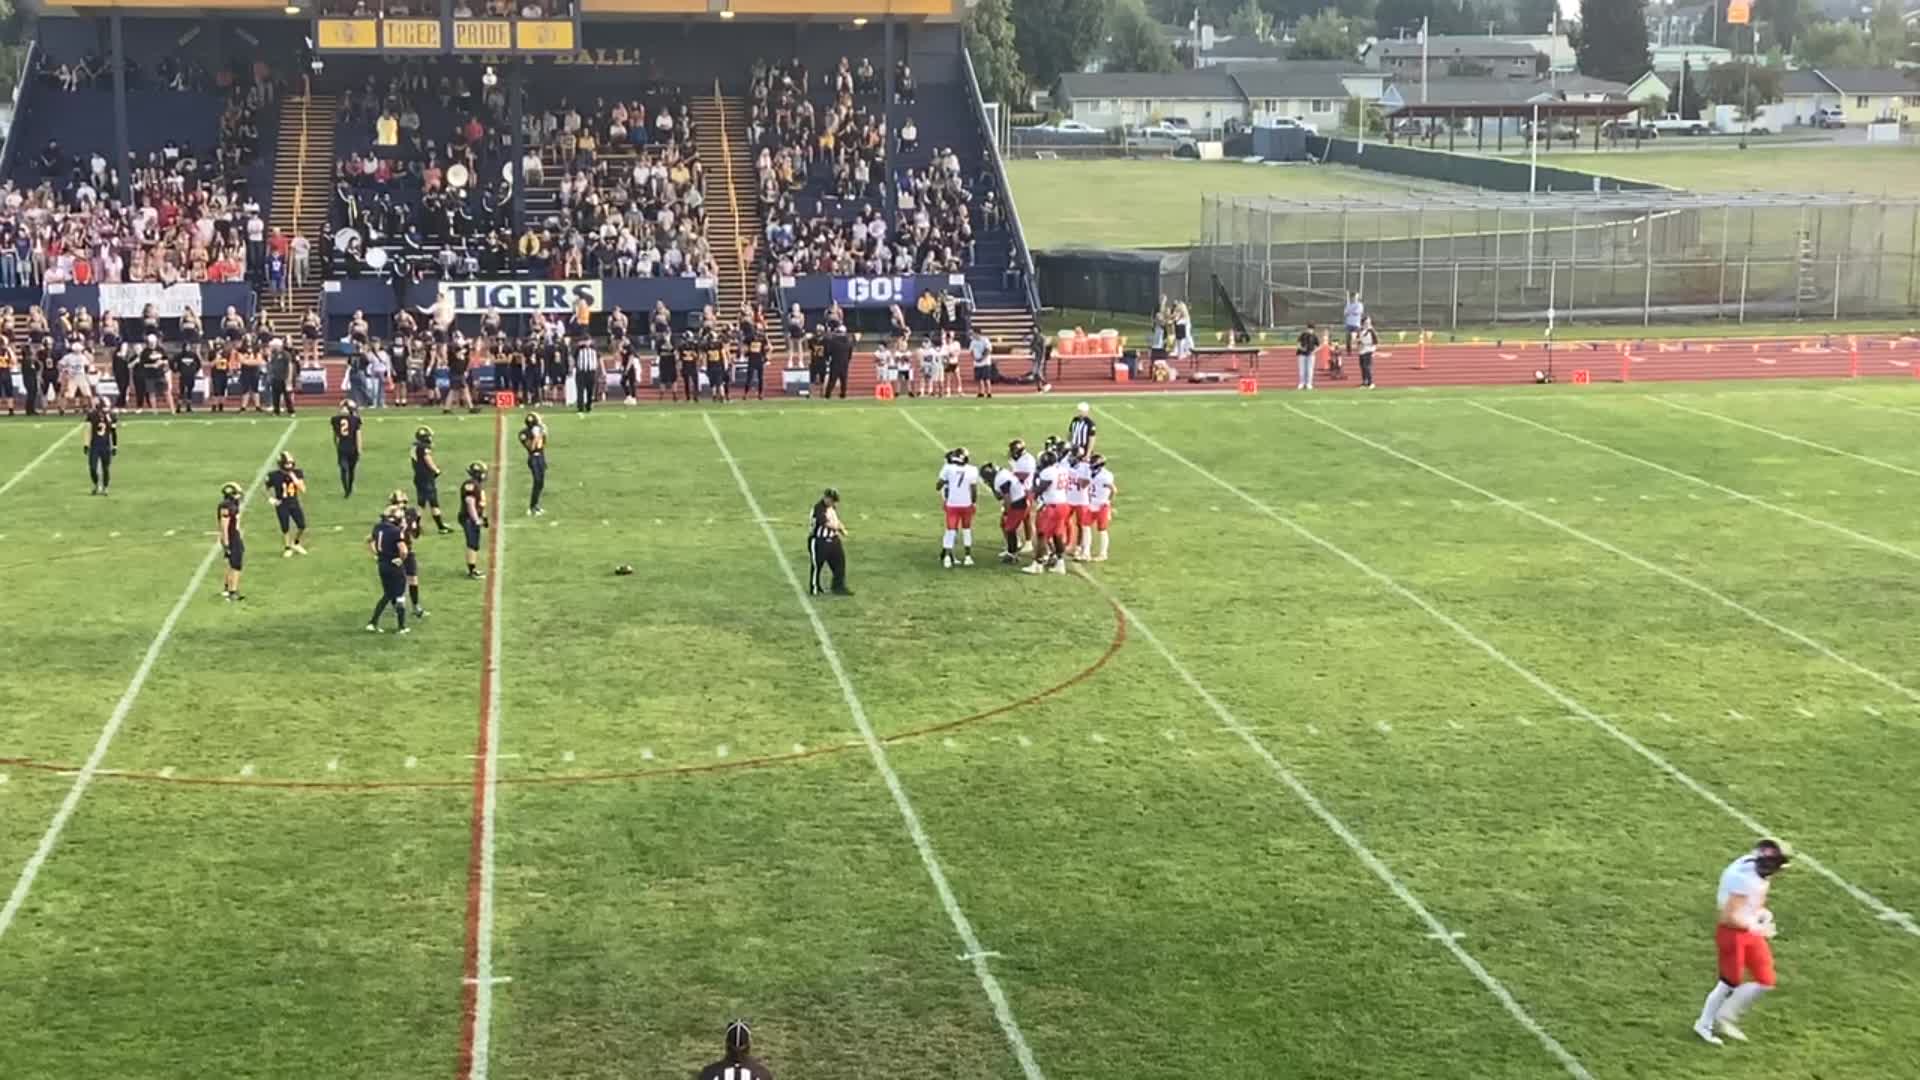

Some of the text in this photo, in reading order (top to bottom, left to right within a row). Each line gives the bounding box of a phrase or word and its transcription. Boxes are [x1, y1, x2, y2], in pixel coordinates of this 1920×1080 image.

[388, 22, 508, 46] TIGER PRIDE
[448, 284, 595, 309] TIGERS
[847, 277, 902, 301] GO!
[97, 422, 106, 436] 3
[340, 419, 349, 436] 2
[956, 470, 965, 488] 7
[377, 530, 384, 551] 1
